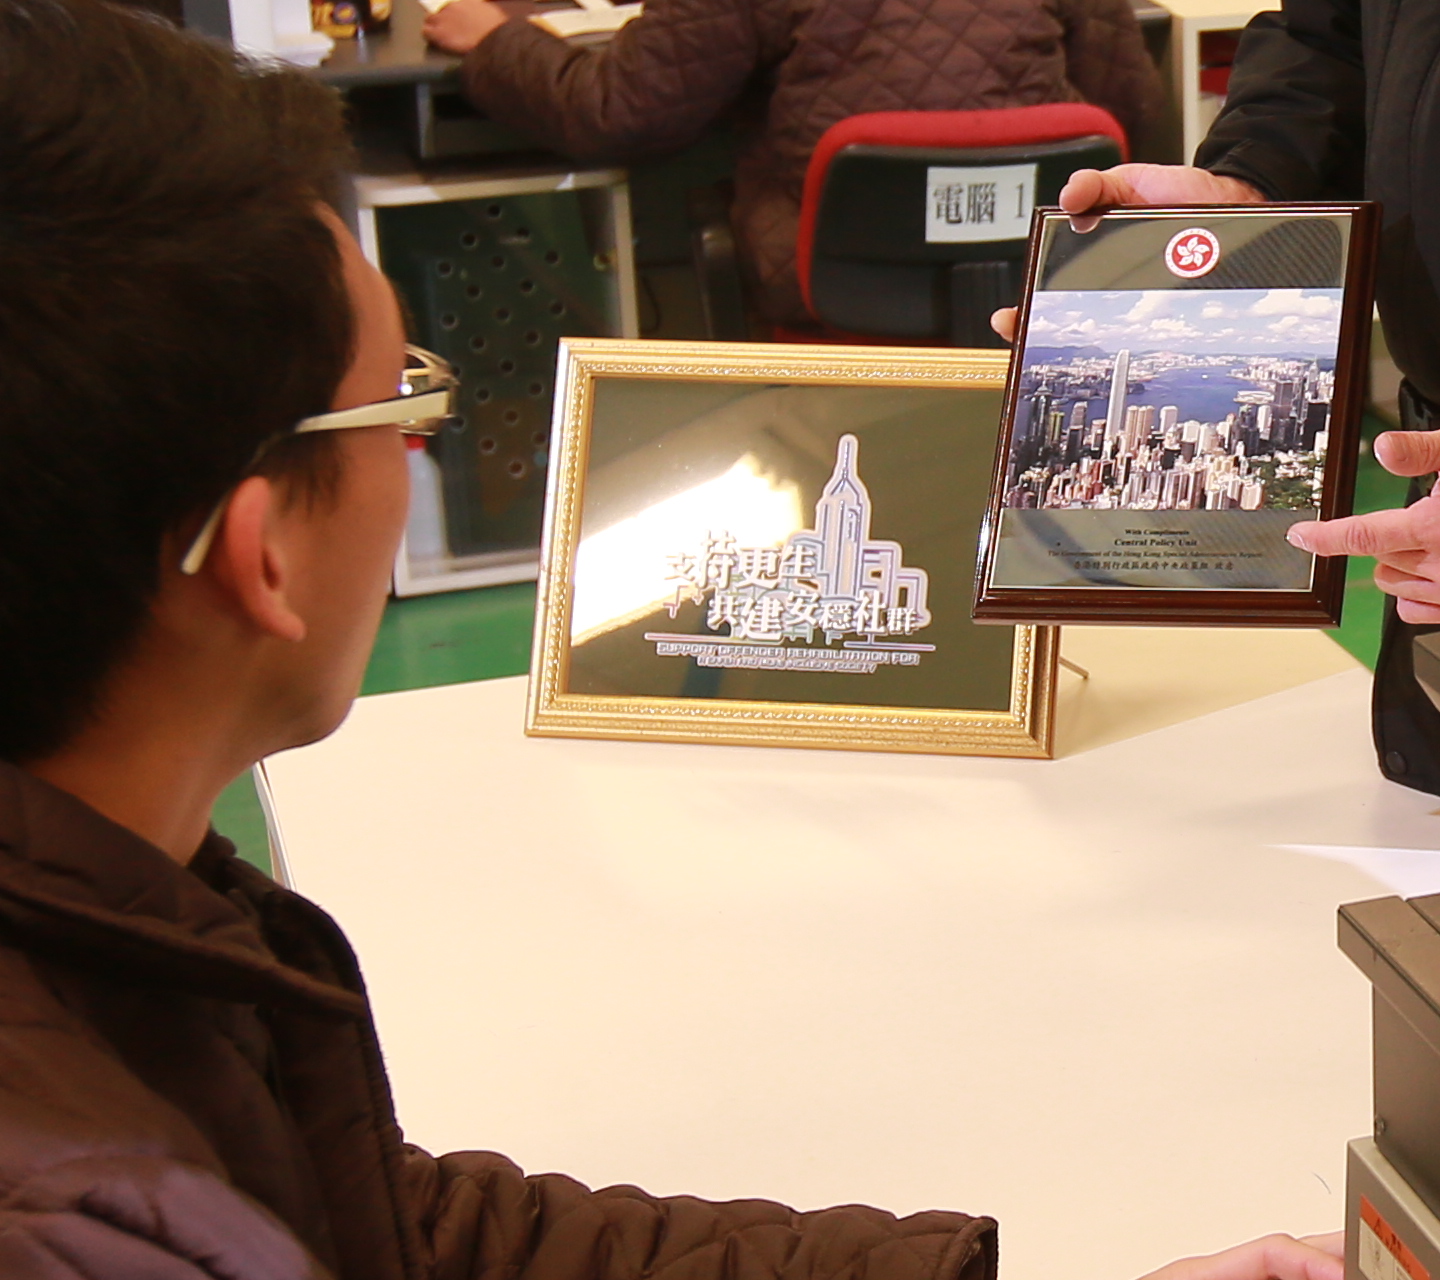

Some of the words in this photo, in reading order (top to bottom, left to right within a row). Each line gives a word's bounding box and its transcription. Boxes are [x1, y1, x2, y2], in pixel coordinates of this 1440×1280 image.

[933, 181, 997, 226] 電腦
[1014, 183, 1026, 219] 1
[1114, 538, 1147, 547] Central
[1149, 538, 1176, 547] Policy
[1178, 539, 1197, 547] Unit
[1125, 528, 1142, 536] With
[664, 530, 815, 589] 支持更生
[707, 589, 920, 641] 共建安穩社群
[657, 642, 717, 656] SUPPORT
[718, 644, 785, 658] OFFENDER
[787, 647, 890, 663] REHABILITATION
[891, 653, 920, 666] FOR
